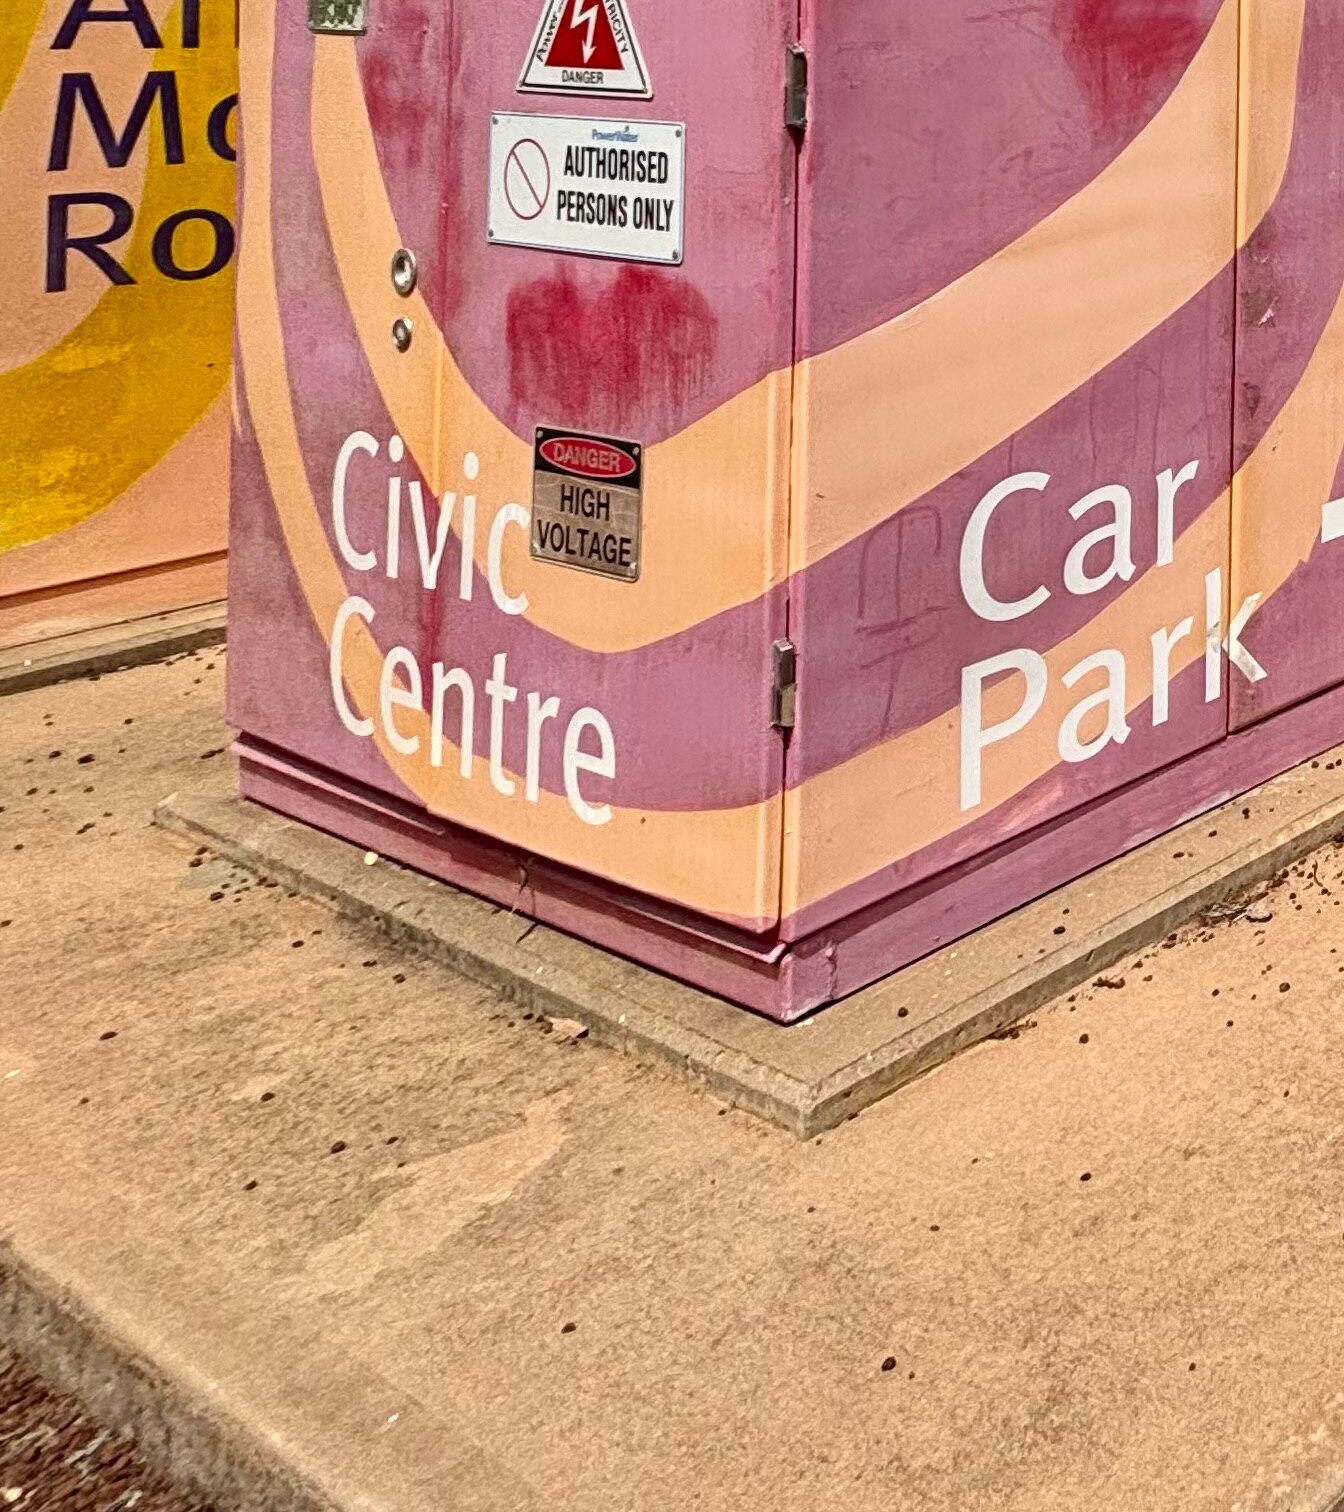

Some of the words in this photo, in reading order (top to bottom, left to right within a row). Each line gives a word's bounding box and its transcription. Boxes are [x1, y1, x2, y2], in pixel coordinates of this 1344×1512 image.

[561, 70, 604, 85] DANGER
[564, 145, 669, 184] AUTHORISED
[557, 189, 628, 228] PERSONS
[633, 196, 675, 232] ONLY
[45, 192, 236, 293] Ro
[553, 442, 621, 473] DANGER
[332, 430, 532, 615] Civic
[560, 483, 610, 521] HIGH
[537, 519, 632, 567] VOLTAGE
[960, 460, 1199, 622] Car
[330, 595, 616, 825] Centre
[960, 568, 1267, 811] Park
